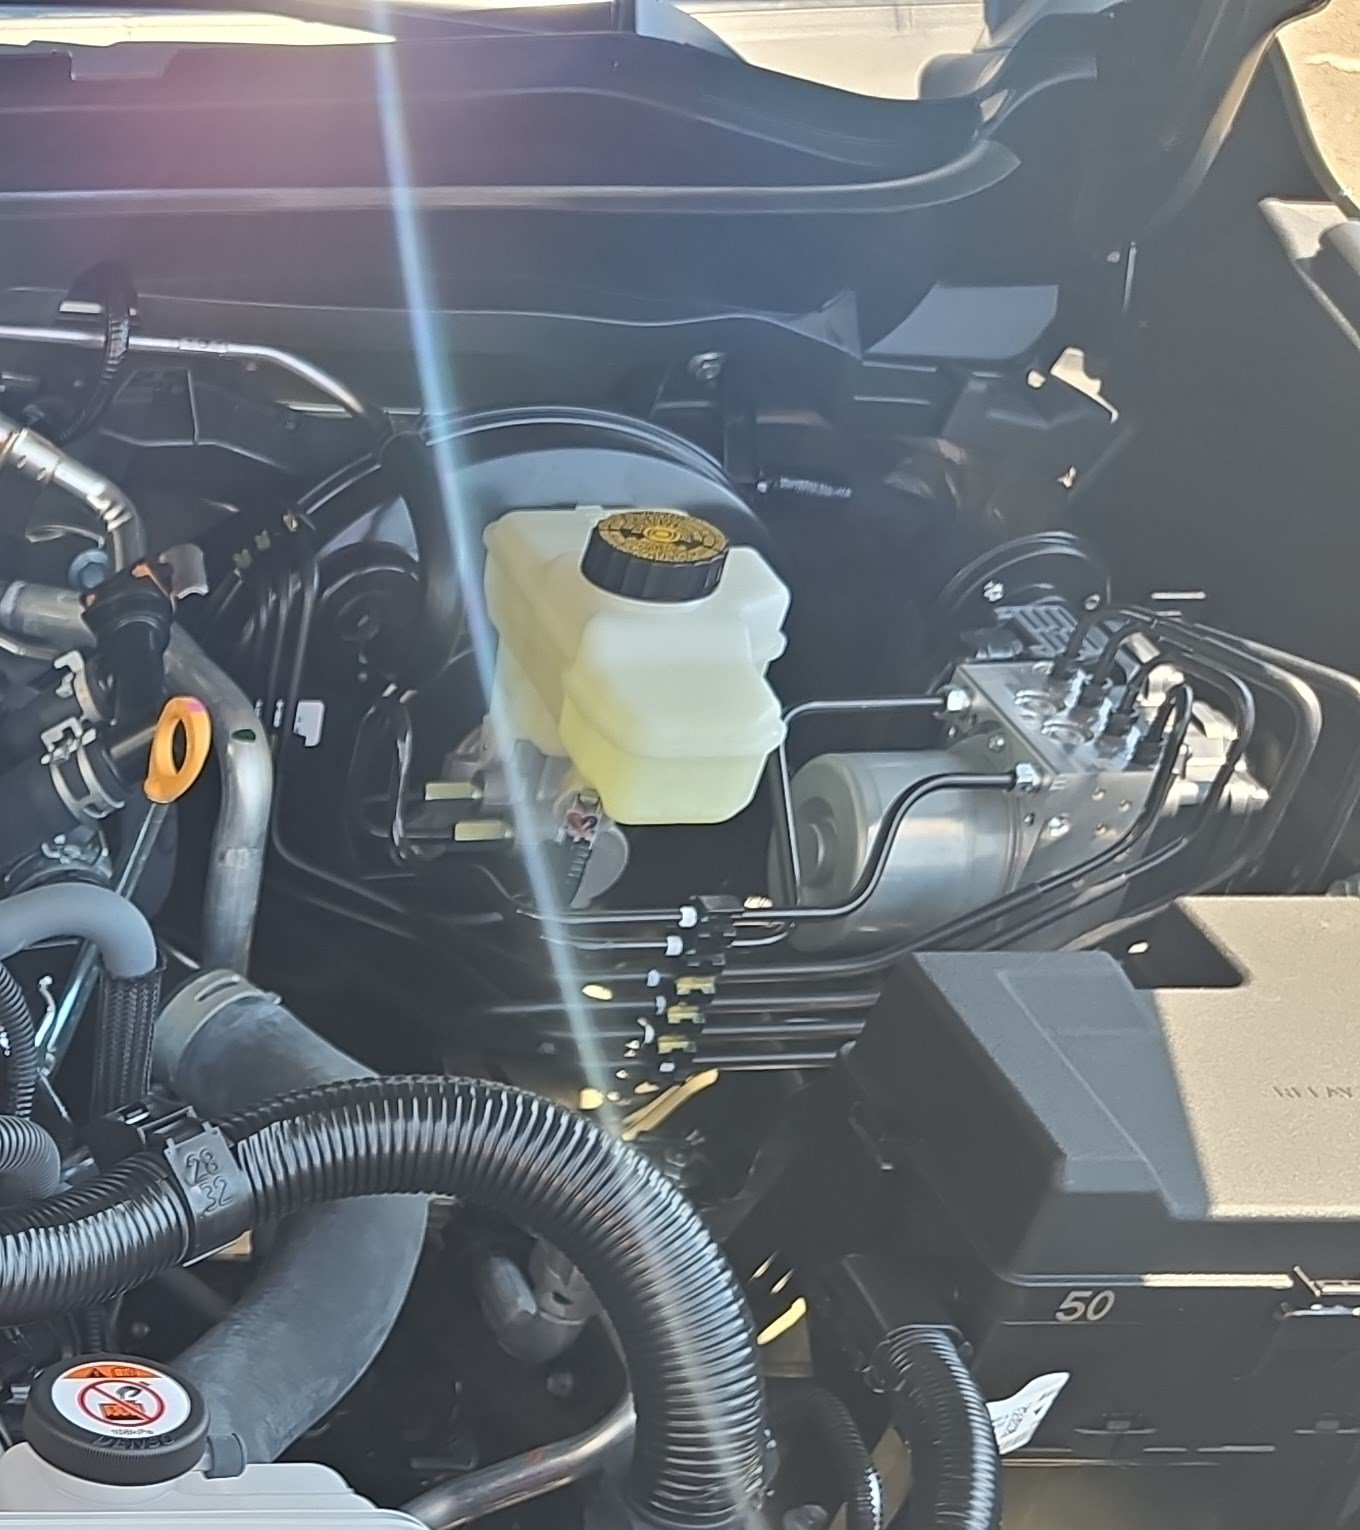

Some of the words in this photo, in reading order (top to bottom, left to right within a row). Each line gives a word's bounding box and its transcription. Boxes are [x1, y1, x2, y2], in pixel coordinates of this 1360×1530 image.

[199, 1175, 235, 1214] 32
[1054, 1290, 1116, 1322] 50
[92, 1434, 177, 1450] DENSO
